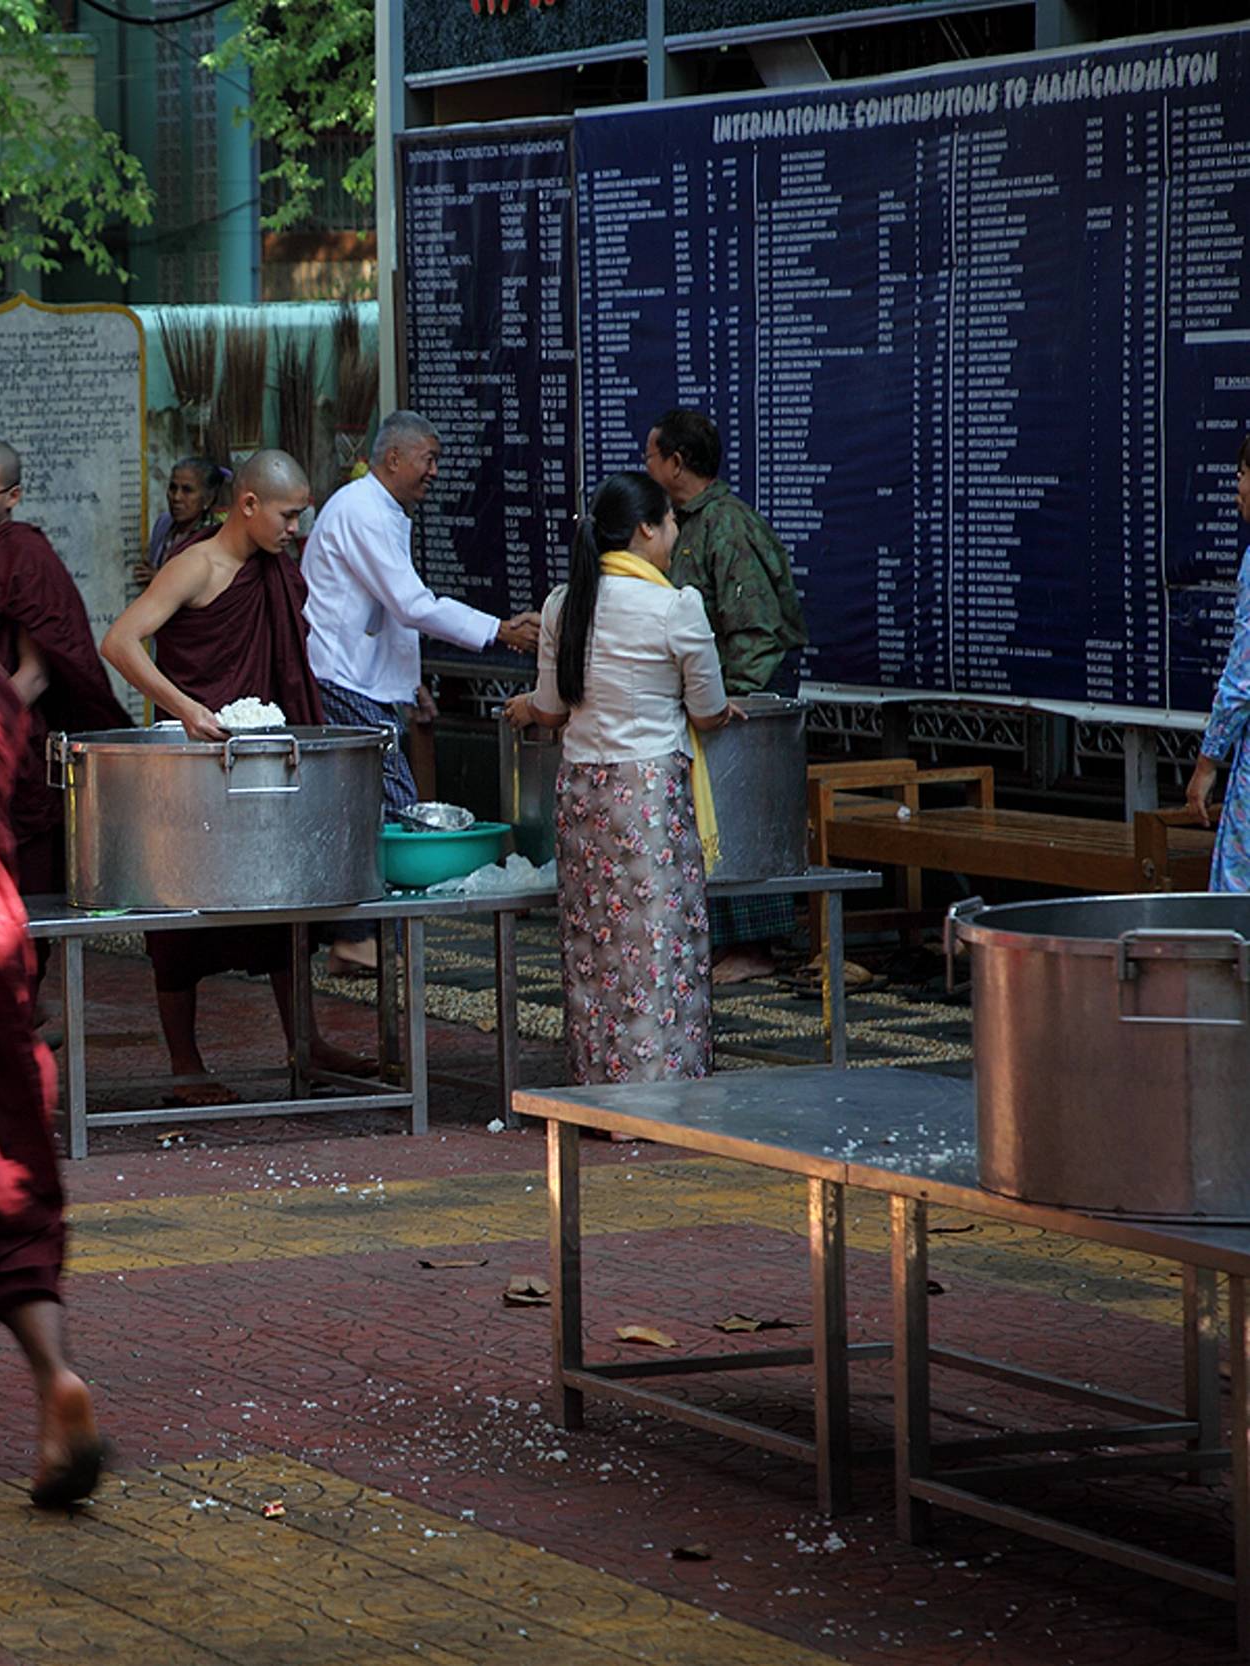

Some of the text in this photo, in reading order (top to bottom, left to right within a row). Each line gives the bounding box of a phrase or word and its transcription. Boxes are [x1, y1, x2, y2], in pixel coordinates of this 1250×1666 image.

[713, 102, 849, 144] INTERNATIONAL
[854, 82, 999, 129] CONTRIBUTIONS
[1004, 76, 1028, 109] TO
